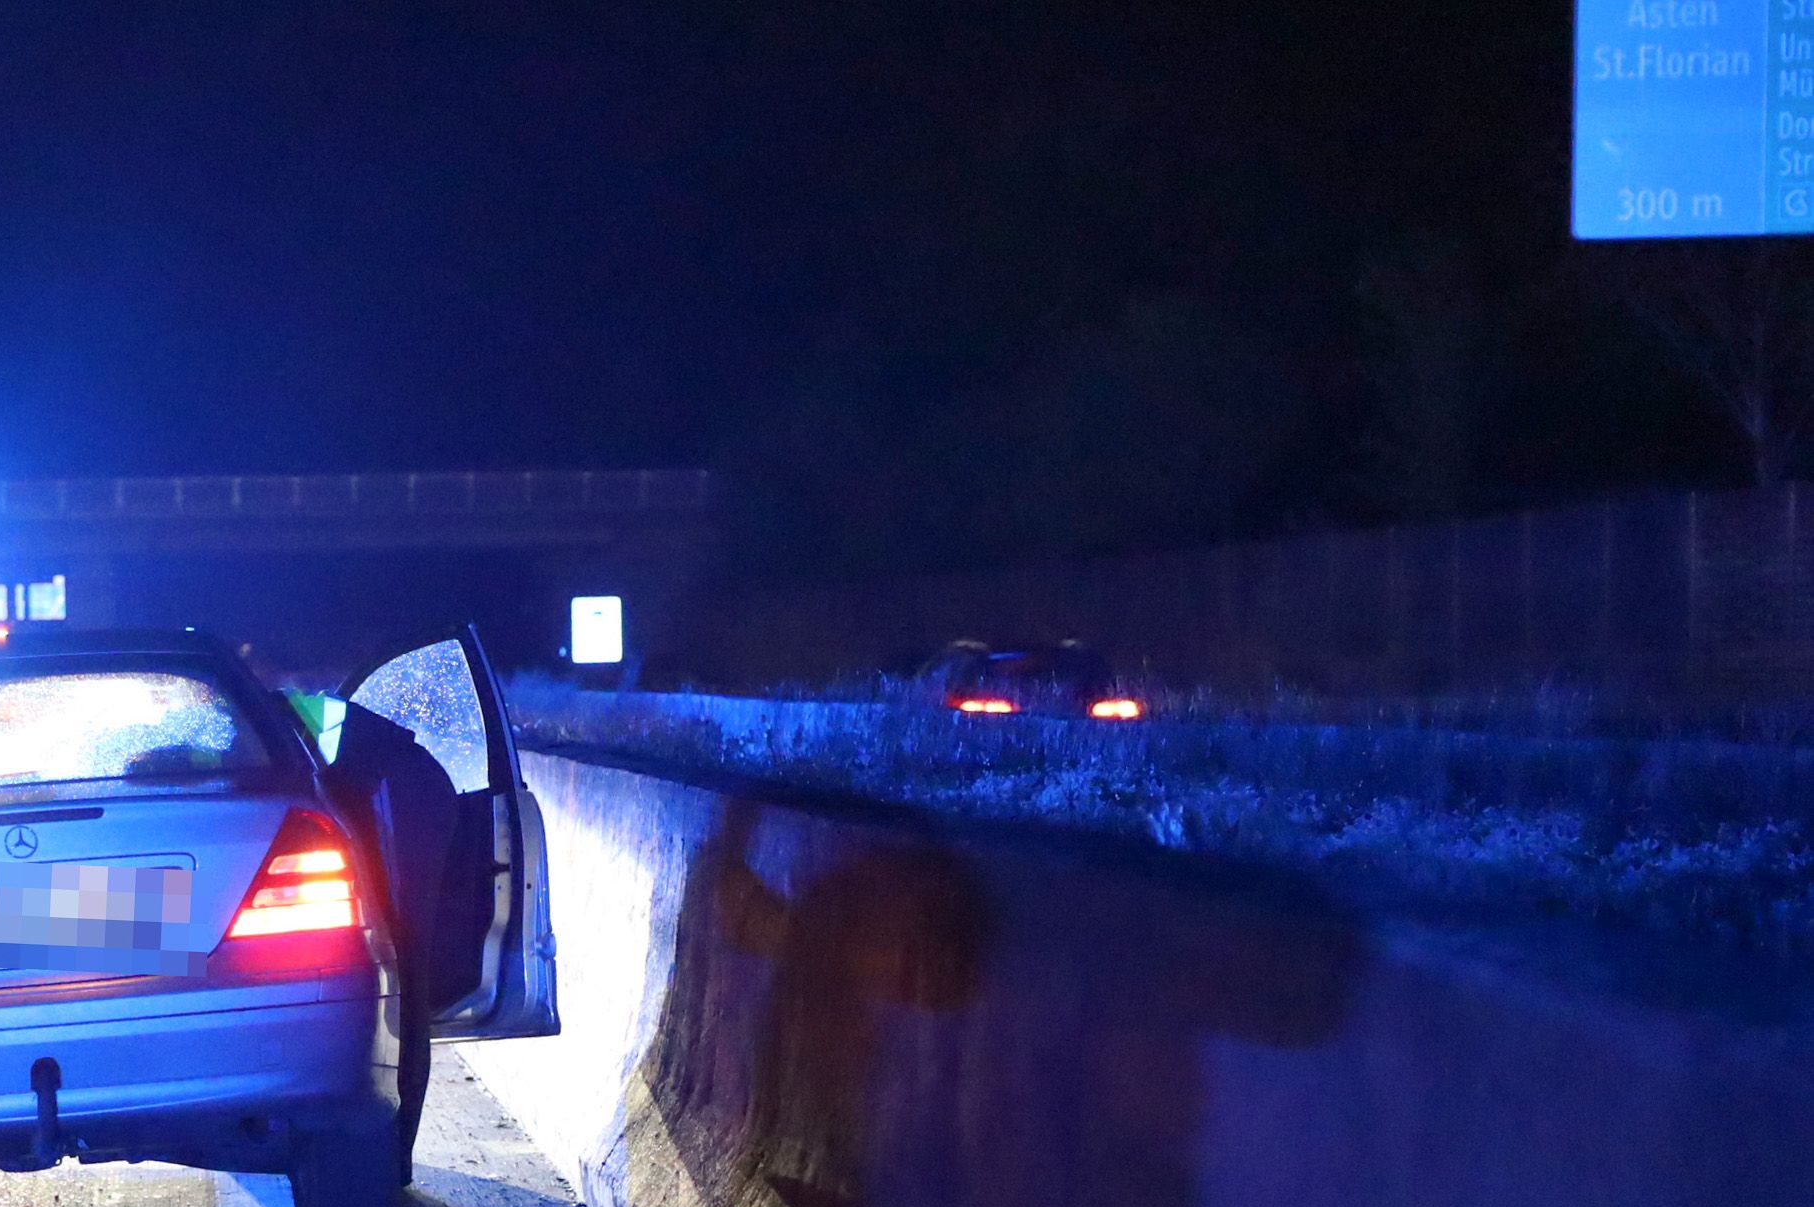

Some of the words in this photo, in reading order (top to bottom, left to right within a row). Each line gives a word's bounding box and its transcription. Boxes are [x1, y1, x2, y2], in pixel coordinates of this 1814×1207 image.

[1594, 43, 1750, 80] St.Florian
[1617, 188, 1678, 221] 300
[1691, 193, 1724, 217] m
